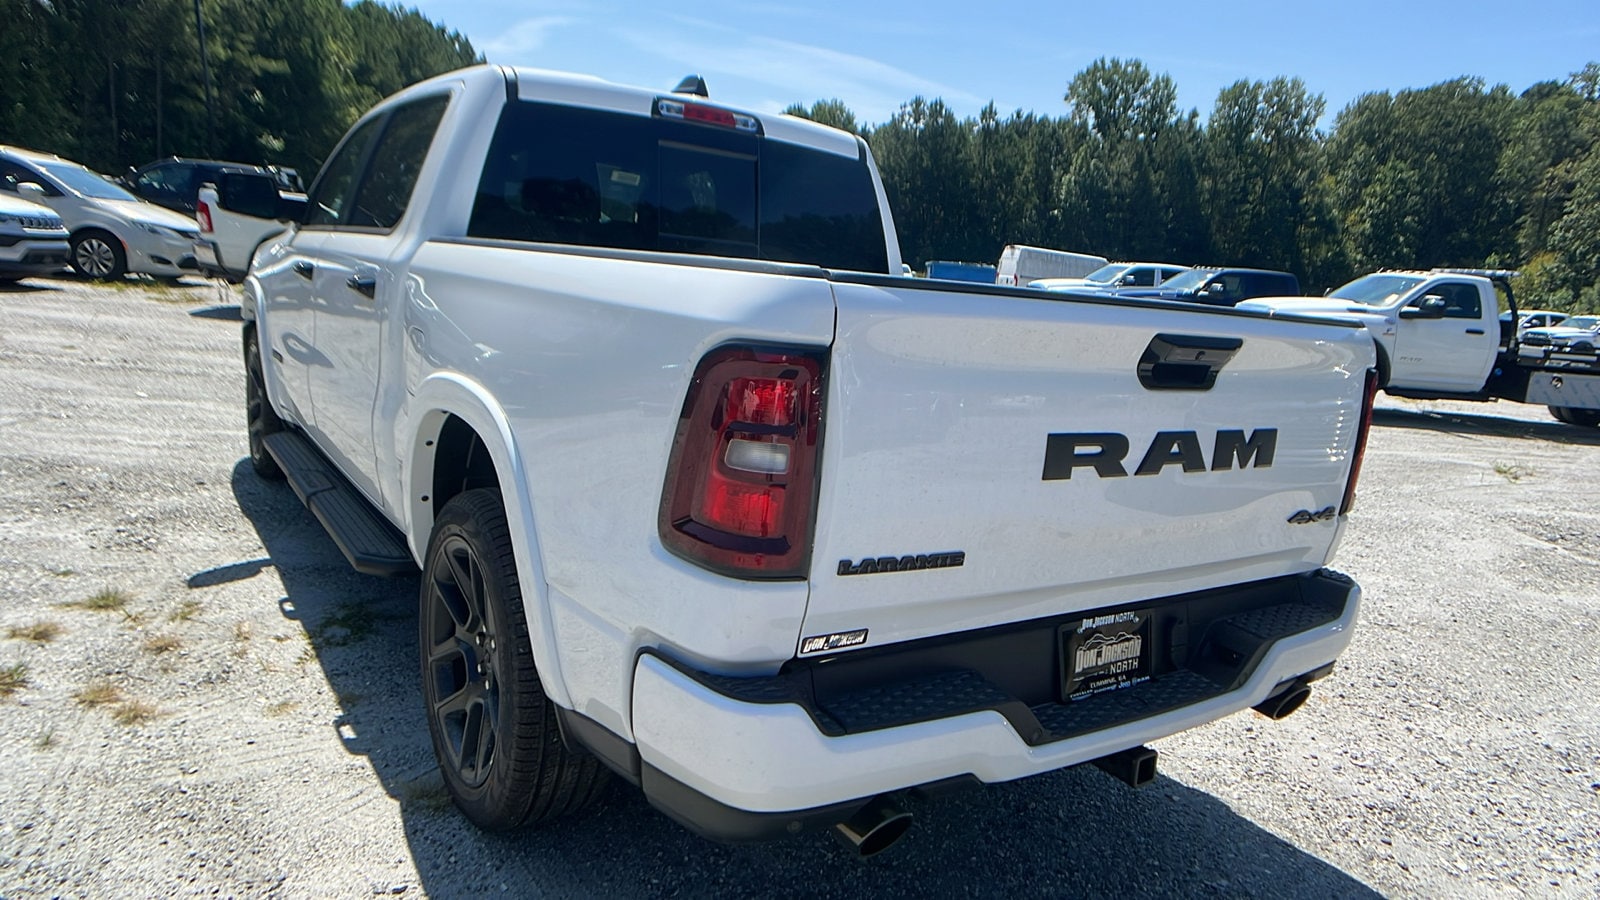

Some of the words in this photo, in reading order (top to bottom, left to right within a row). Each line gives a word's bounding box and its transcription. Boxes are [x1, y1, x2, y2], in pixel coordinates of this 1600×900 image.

[1041, 427, 1278, 481] RAM
[836, 550, 966, 576] LARAMIE
[1109, 658, 1139, 675] NORTH
